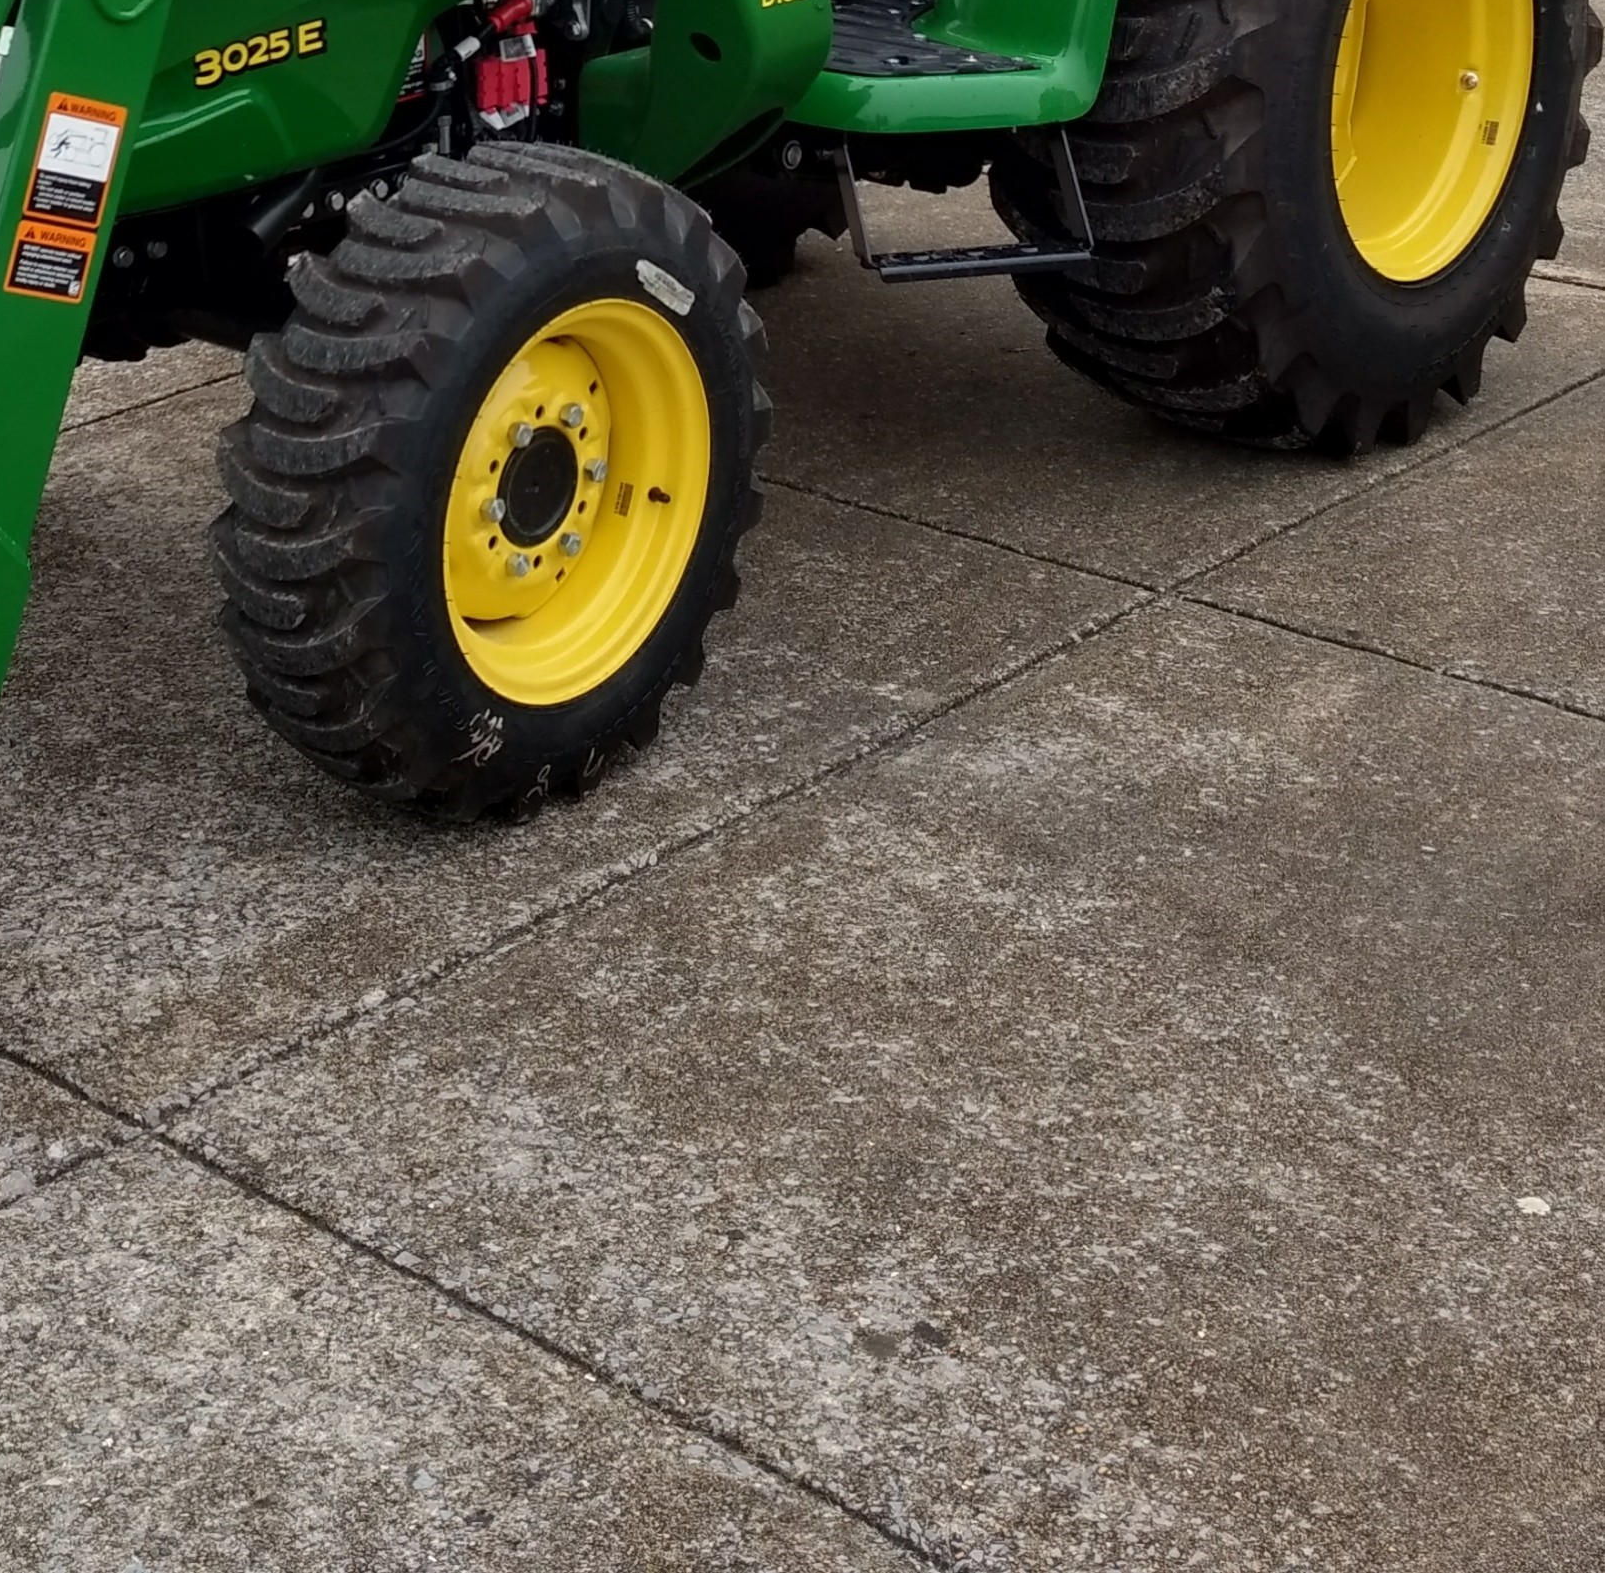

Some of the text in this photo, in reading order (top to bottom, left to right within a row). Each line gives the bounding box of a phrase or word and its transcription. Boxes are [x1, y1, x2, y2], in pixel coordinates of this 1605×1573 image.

[195, 19, 323, 86] 3025 E
[70, 103, 116, 122] WARNING
[39, 229, 87, 248] WARNING
